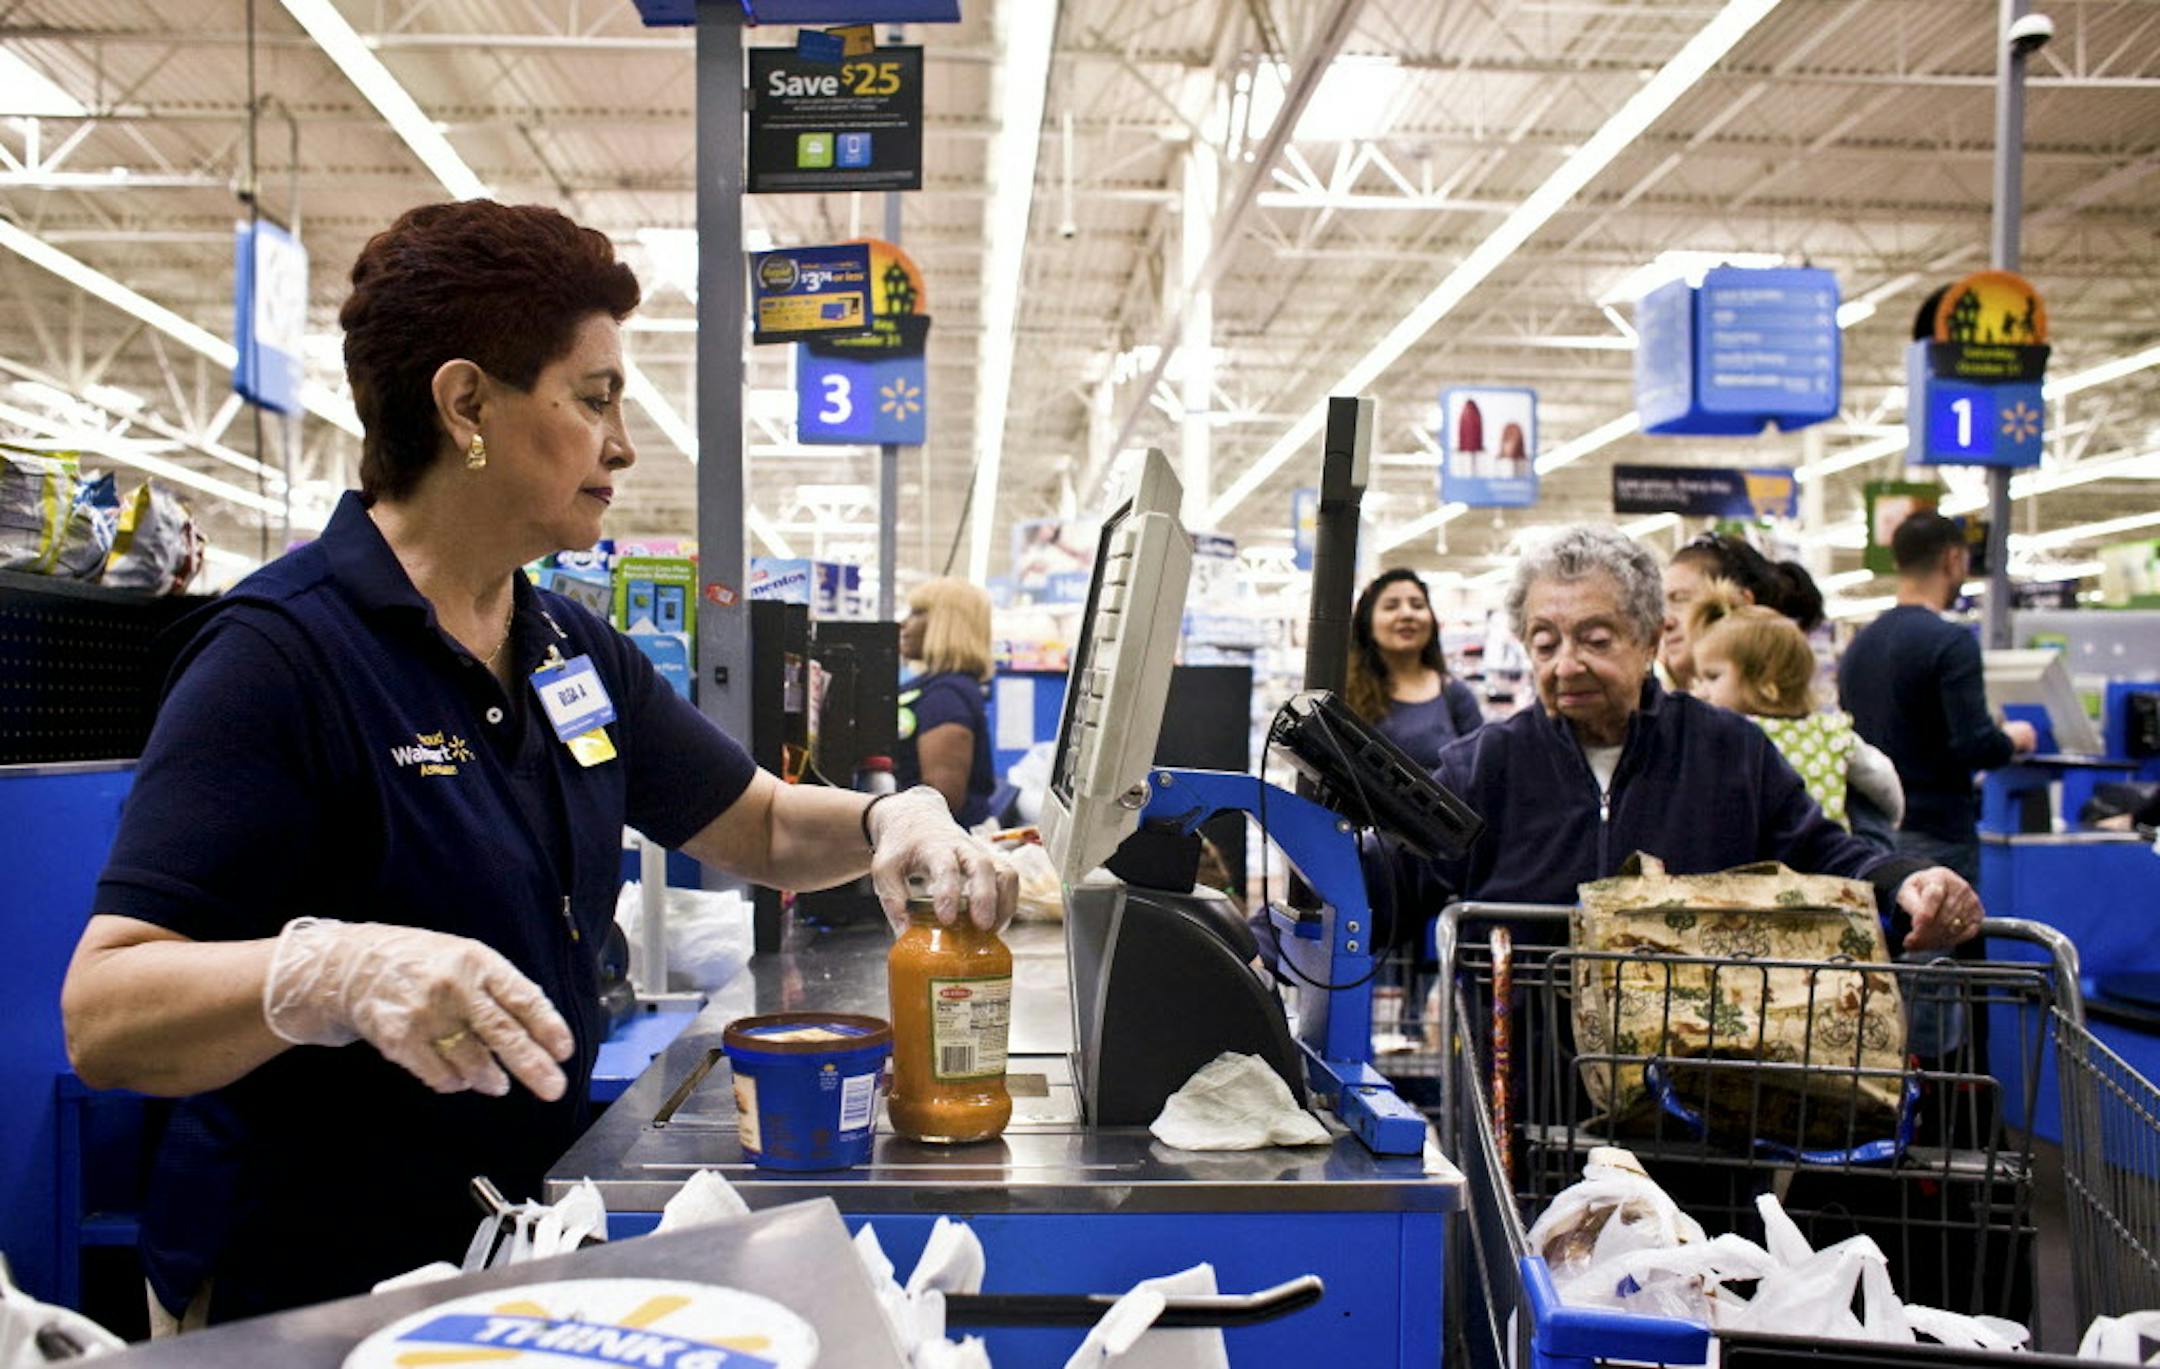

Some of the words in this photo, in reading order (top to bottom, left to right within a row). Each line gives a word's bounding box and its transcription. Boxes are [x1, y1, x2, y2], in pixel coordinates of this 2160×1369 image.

[769, 70, 838, 96] Save
[841, 63, 903, 95] $25
[818, 374, 853, 424] 3
[1951, 398, 1972, 447] 1
[752, 572, 806, 595] mentos
[473, 1317, 688, 1368] THINK
